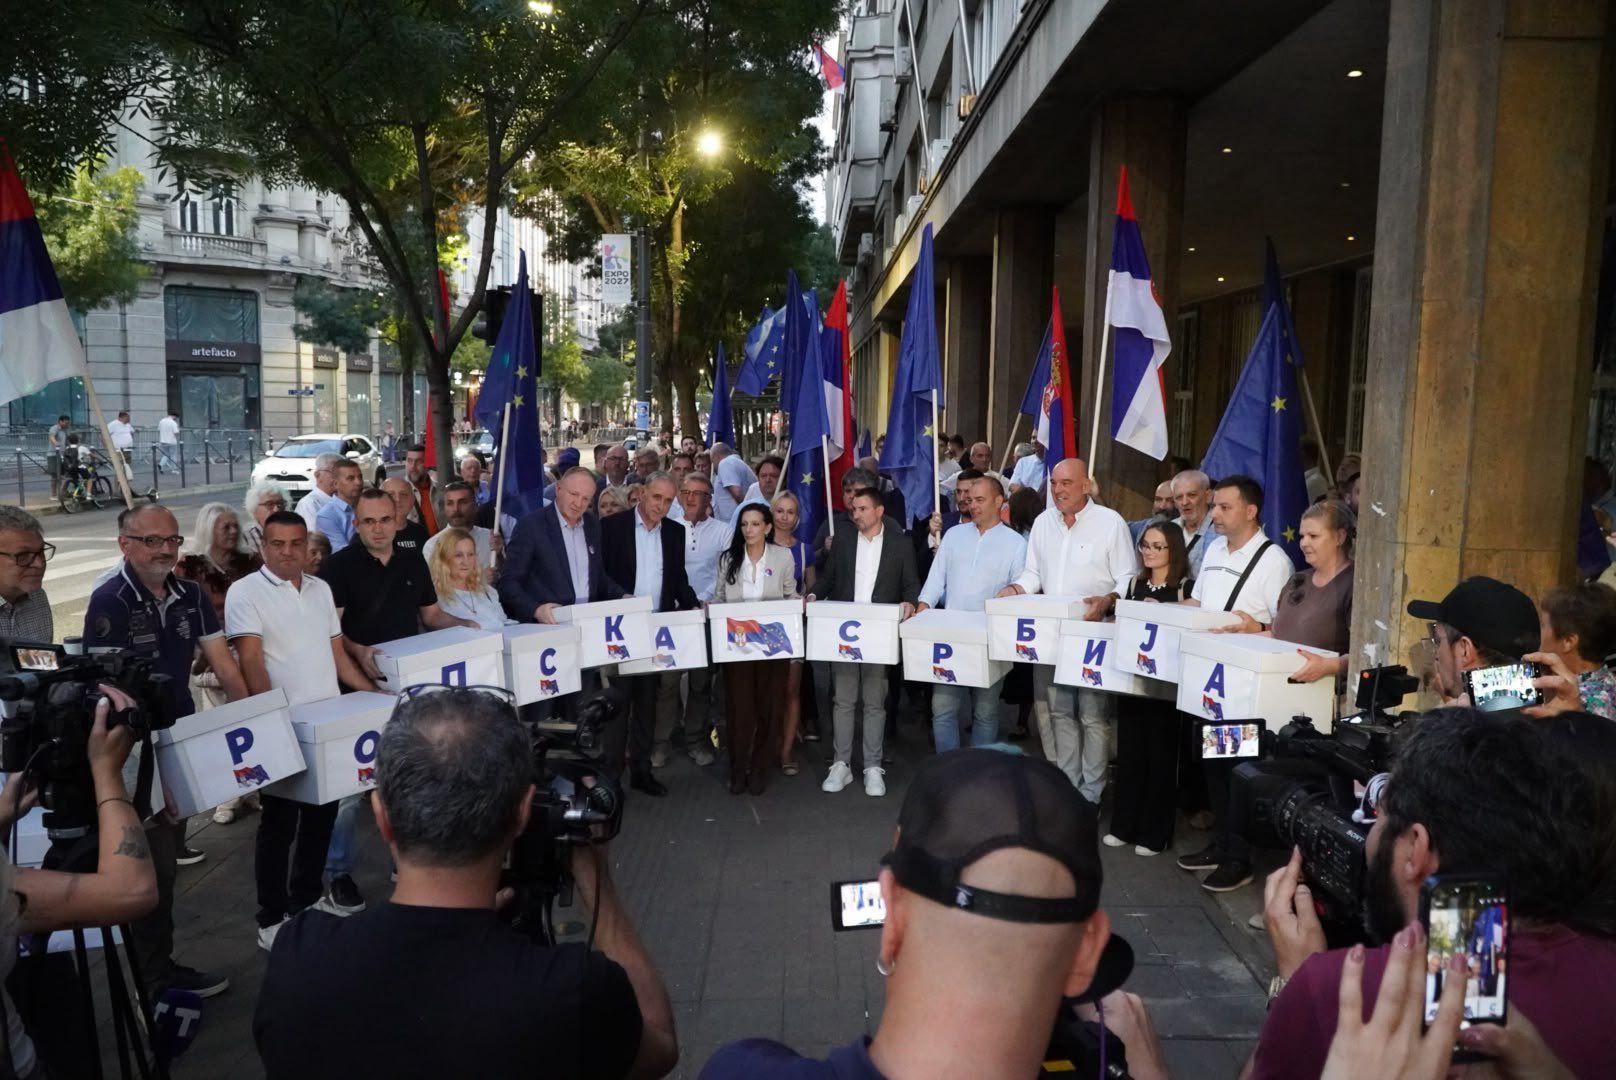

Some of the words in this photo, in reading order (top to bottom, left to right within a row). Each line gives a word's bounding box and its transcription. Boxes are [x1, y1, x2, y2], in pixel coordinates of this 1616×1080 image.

[604, 270, 629, 278] EXPO
[191, 347, 236, 357] artefacto
[605, 615, 625, 642] К
[655, 626, 676, 650] А
[838, 620, 861, 642] С
[1017, 617, 1036, 643] Б
[1139, 622, 1159, 653] Ј
[540, 648, 557, 676] С
[932, 642, 954, 664] Р
[1082, 639, 1108, 667] И
[1203, 663, 1226, 699] А
[224, 727, 254, 765] Р
[353, 730, 381, 764] О
